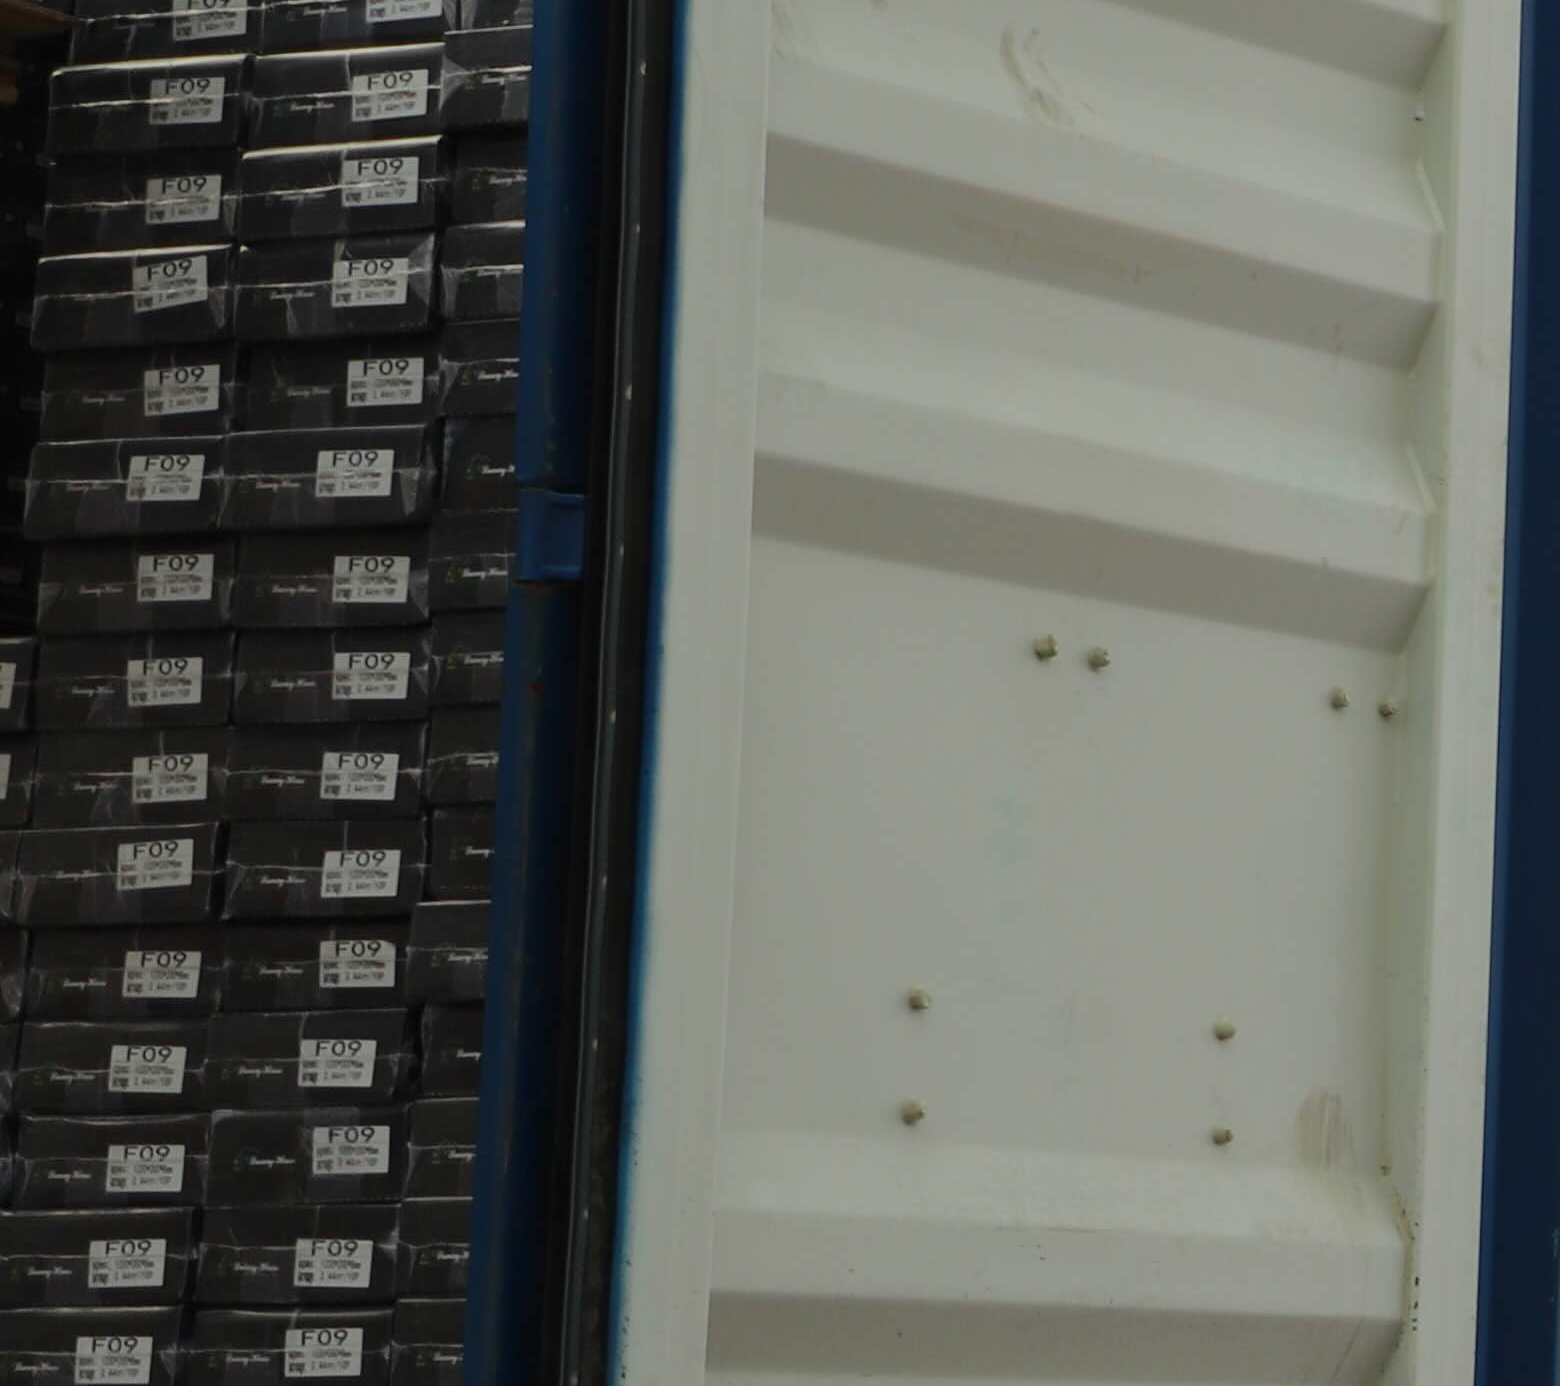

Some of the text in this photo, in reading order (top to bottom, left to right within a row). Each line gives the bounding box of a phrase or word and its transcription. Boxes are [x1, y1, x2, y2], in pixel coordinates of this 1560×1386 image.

[165, 79, 210, 96] F09
[367, 72, 413, 90] F09
[357, 158, 403, 176] F09
[161, 176, 206, 194] F09
[147, 260, 192, 279] F09
[347, 259, 394, 276] F09
[158, 366, 205, 384] F09
[363, 359, 409, 376] F09
[144, 456, 190, 473] F09
[331, 451, 378, 468] F09
[153, 556, 199, 573] F09
[348, 557, 394, 574] F09
[143, 658, 188, 676] F09
[348, 653, 394, 670] F09
[147, 755, 193, 773] F09
[338, 753, 384, 771] F09
[132, 842, 179, 859] F09
[339, 851, 385, 868] F09
[334, 942, 380, 959] F09
[140, 951, 186, 969] F09
[127, 1046, 173, 1064] F09
[315, 1041, 361, 1058] F09
[328, 1126, 375, 1144] F09
[123, 1145, 169, 1163] F09
[104, 1240, 150, 1258] F09
[311, 1240, 357, 1258] F09
[91, 1337, 138, 1354] F09
[300, 1329, 347, 1348] F09
